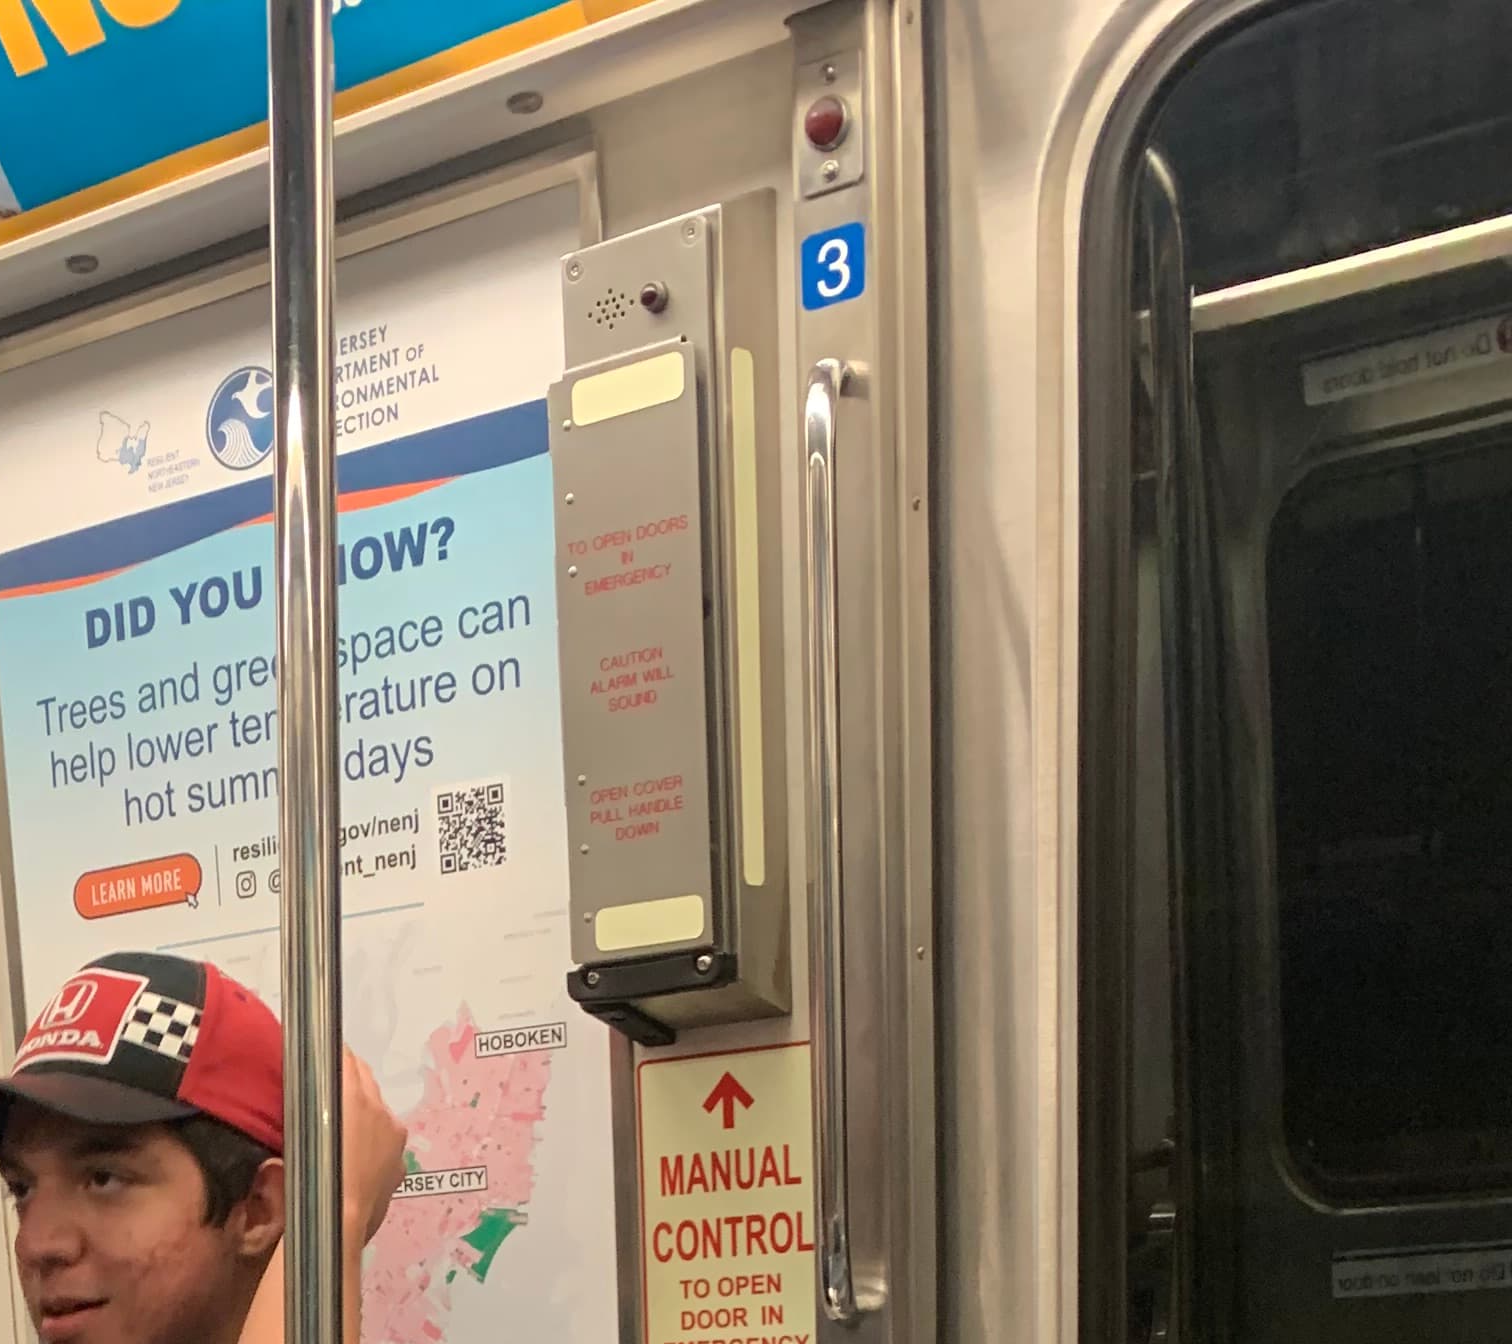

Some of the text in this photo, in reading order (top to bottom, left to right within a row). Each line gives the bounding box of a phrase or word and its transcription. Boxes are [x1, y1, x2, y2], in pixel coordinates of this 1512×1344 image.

[817, 238, 850, 297] 3
[406, 344, 424, 361] OF
[568, 514, 688, 556] TO OPEN DOORS
[620, 551, 634, 565] IN
[85, 516, 456, 649] DID YOU OW?
[584, 563, 672, 596] EMERGENCY
[36, 690, 126, 737] Trees
[137, 661, 200, 714] and
[458, 594, 530, 640] can
[600, 648, 663, 672] CAUTION
[590, 666, 675, 695] ALARM WILL
[608, 690, 657, 712] SOUND
[50, 741, 116, 789] help
[128, 722, 218, 771] lower
[472, 657, 521, 697] on
[124, 780, 177, 826] hot
[344, 735, 434, 783] days
[590, 774, 683, 805] OPEN COVER
[590, 795, 684, 824] PULL HANDLE
[615, 820, 660, 841] DOWN
[90, 868, 182, 906] LEARN MORE
[478, 1027, 563, 1052] HOBOKEN
[449, 1170, 484, 1188] CITY
[660, 1144, 802, 1197] MANUAL
[652, 1211, 814, 1263] CONTROL
[680, 1273, 782, 1299] TO OPEN
[681, 1304, 784, 1330] DOOR IN
